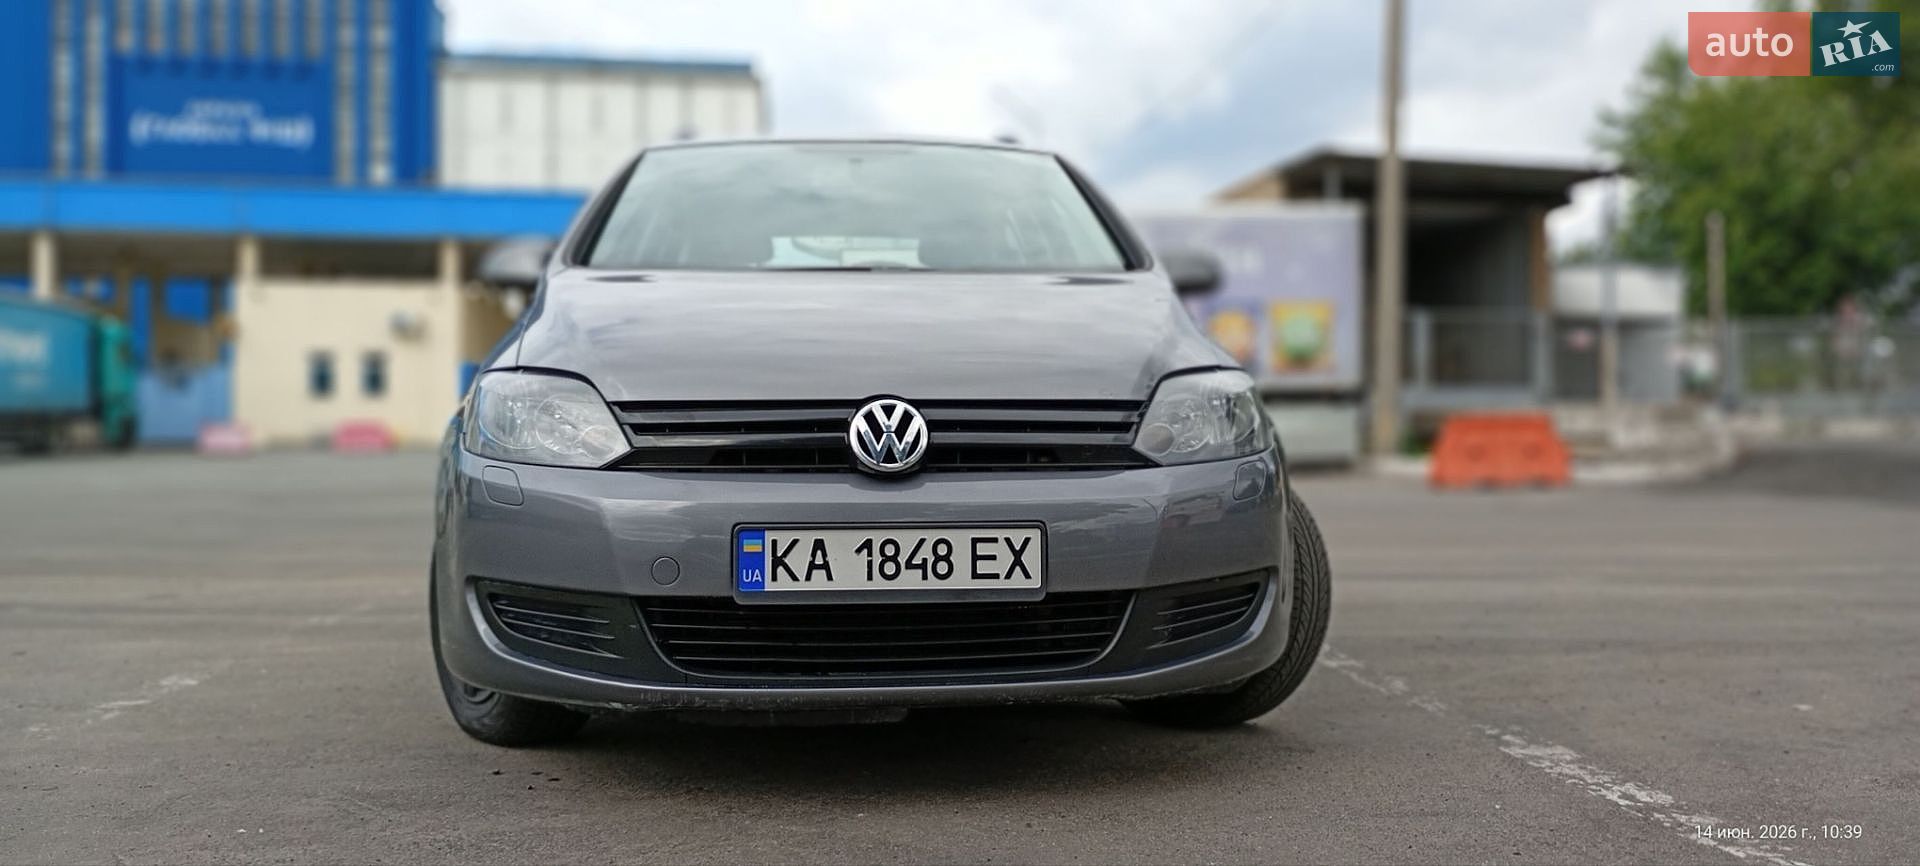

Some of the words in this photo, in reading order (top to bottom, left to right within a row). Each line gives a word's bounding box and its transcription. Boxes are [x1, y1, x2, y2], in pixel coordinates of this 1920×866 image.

[770, 538, 834, 582] KA
[854, 537, 954, 581] 1848
[970, 537, 1032, 580] EX
[742, 569, 762, 583] UA
